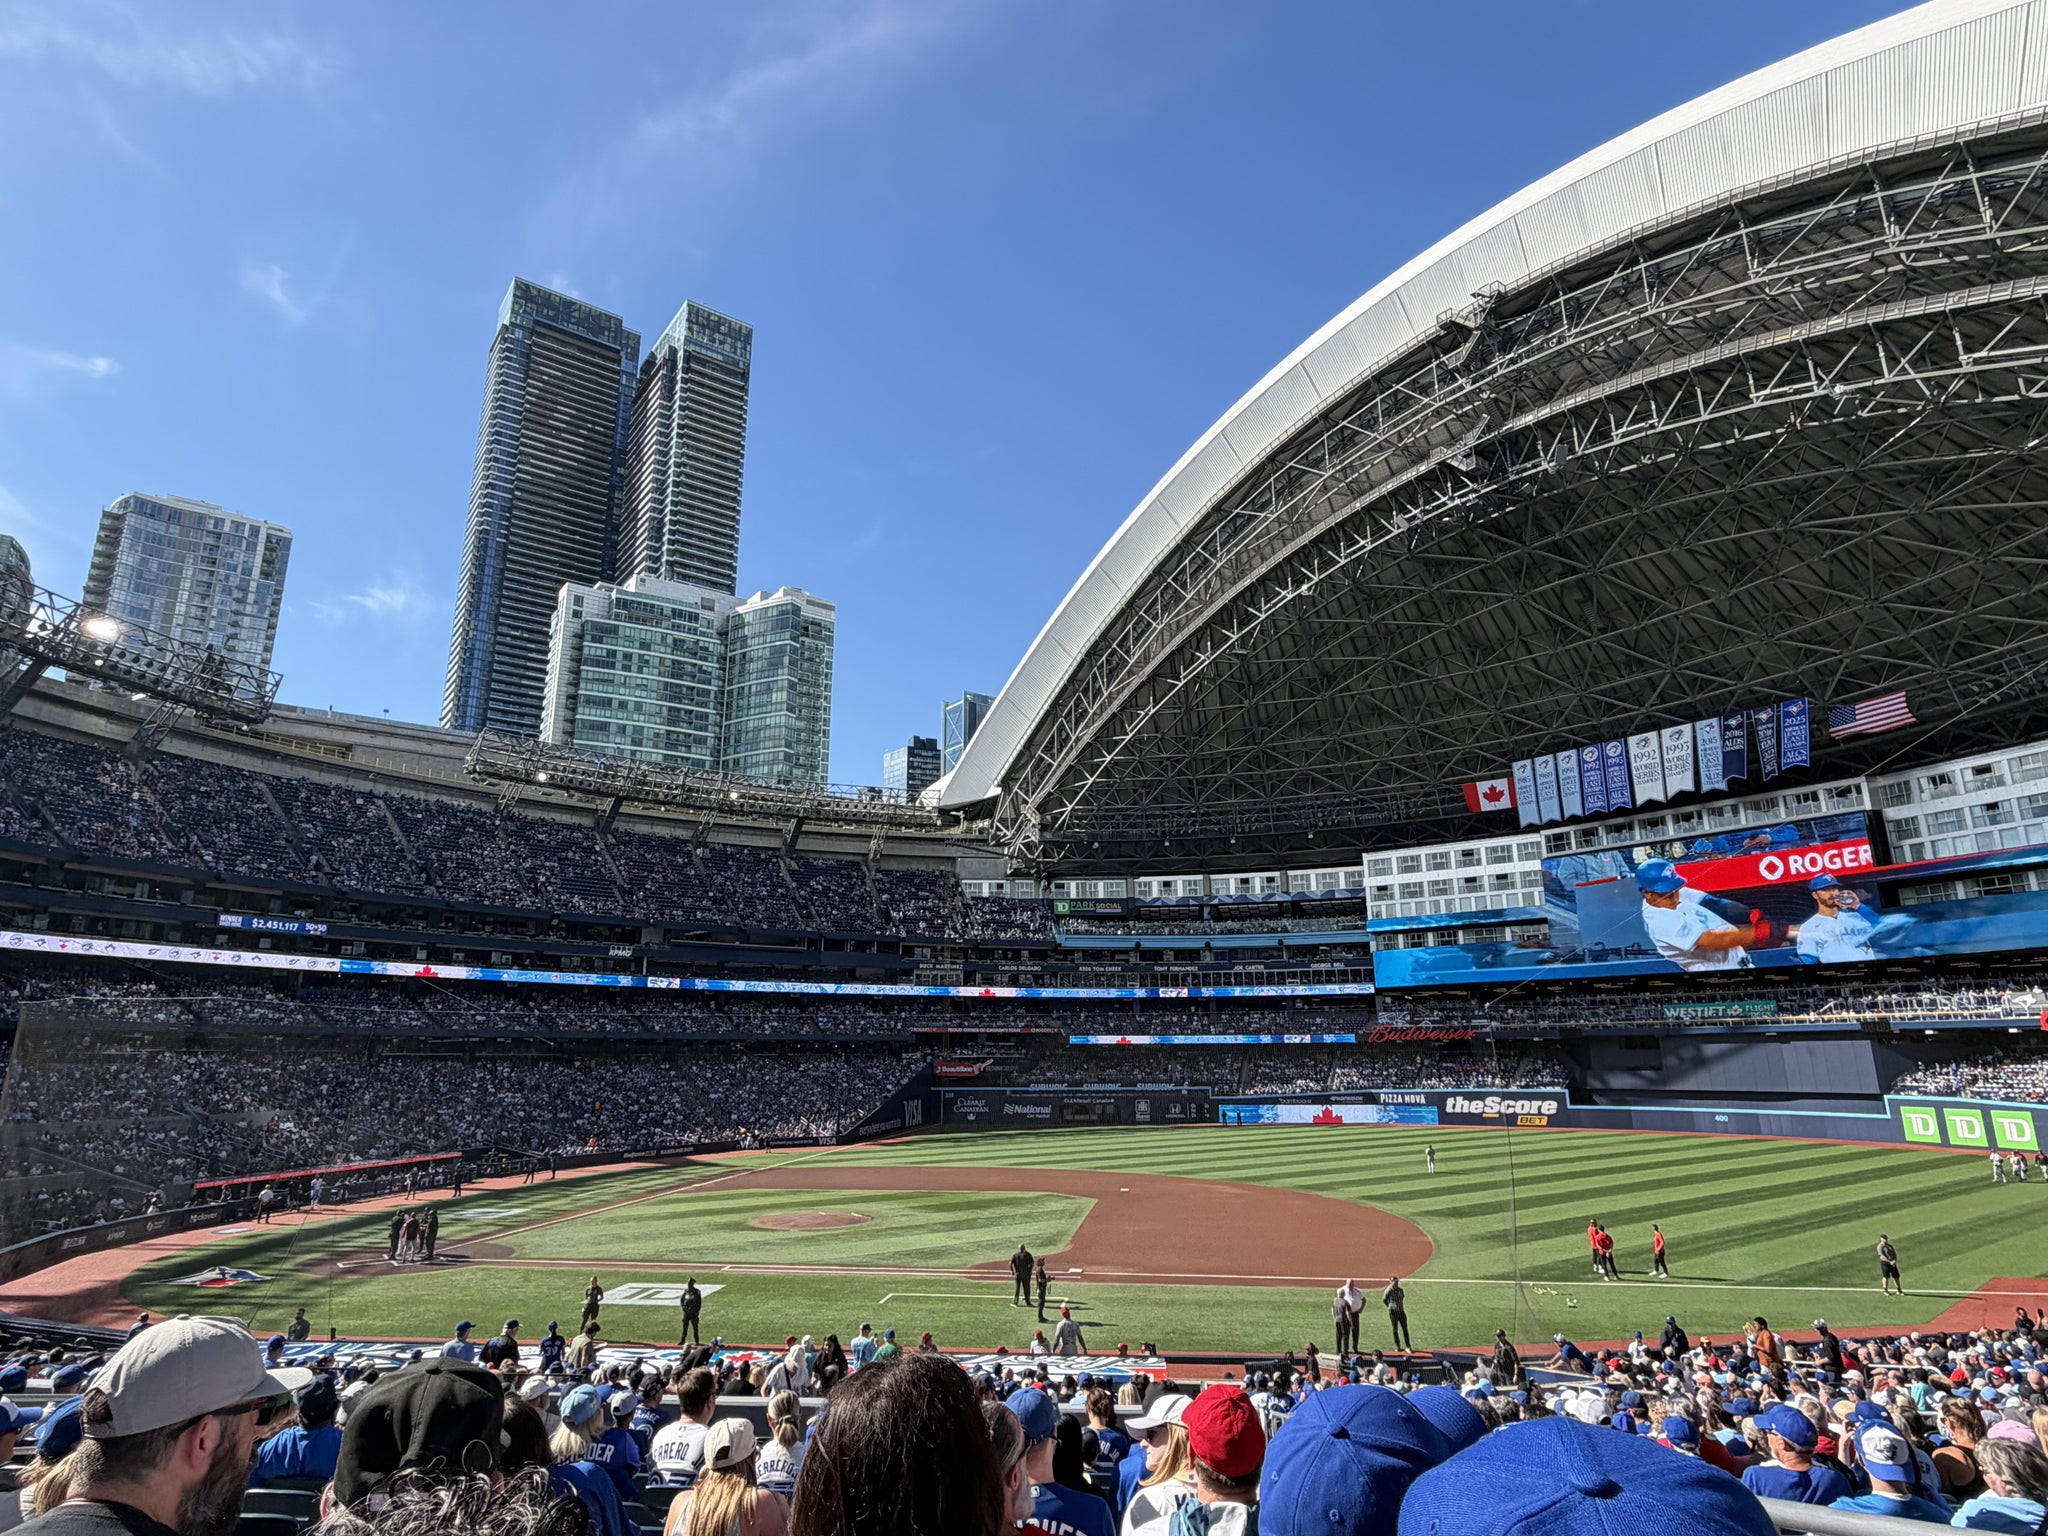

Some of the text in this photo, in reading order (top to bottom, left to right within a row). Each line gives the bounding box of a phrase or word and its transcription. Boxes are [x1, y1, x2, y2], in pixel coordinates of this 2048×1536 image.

[1784, 715, 1806, 726] 2025
[1724, 730, 1744, 738] 2016
[1700, 737, 1718, 746] 2015
[1725, 738, 1744, 747] ALDS
[1666, 741, 1690, 756] 1993
[1608, 757, 1623, 766] 1993
[1634, 749, 1657, 764] 1992
[1666, 753, 1690, 764] WORLD
[1584, 761, 1600, 771] 1992
[1634, 762, 1659, 772] WORLD
[1666, 762, 1690, 771] SERIES
[1634, 770, 1660, 780] SERIES
[1055, 903, 1068, 912] TD
[1071, 901, 1095, 910] PARK
[252, 918, 298, 932] $2,451,117
[608, 948, 632, 957] KPMG
[1364, 1024, 1476, 1042] Budweiser
[958, 1097, 986, 1106] CLEARLY
[1380, 1093, 1426, 1104] PIZZA NOVA
[1014, 1104, 1052, 1114] National
[1446, 1096, 1558, 1114] theScore
[904, 1100, 922, 1127] VISA
[1904, 1114, 1936, 1135] TD
[1948, 1116, 1982, 1138] TD
[1996, 1118, 2032, 1141] TD
[198, 1212, 218, 1220] clover
[654, 1442, 690, 1460] ERRERO
[758, 1460, 795, 1476] ERRERO
